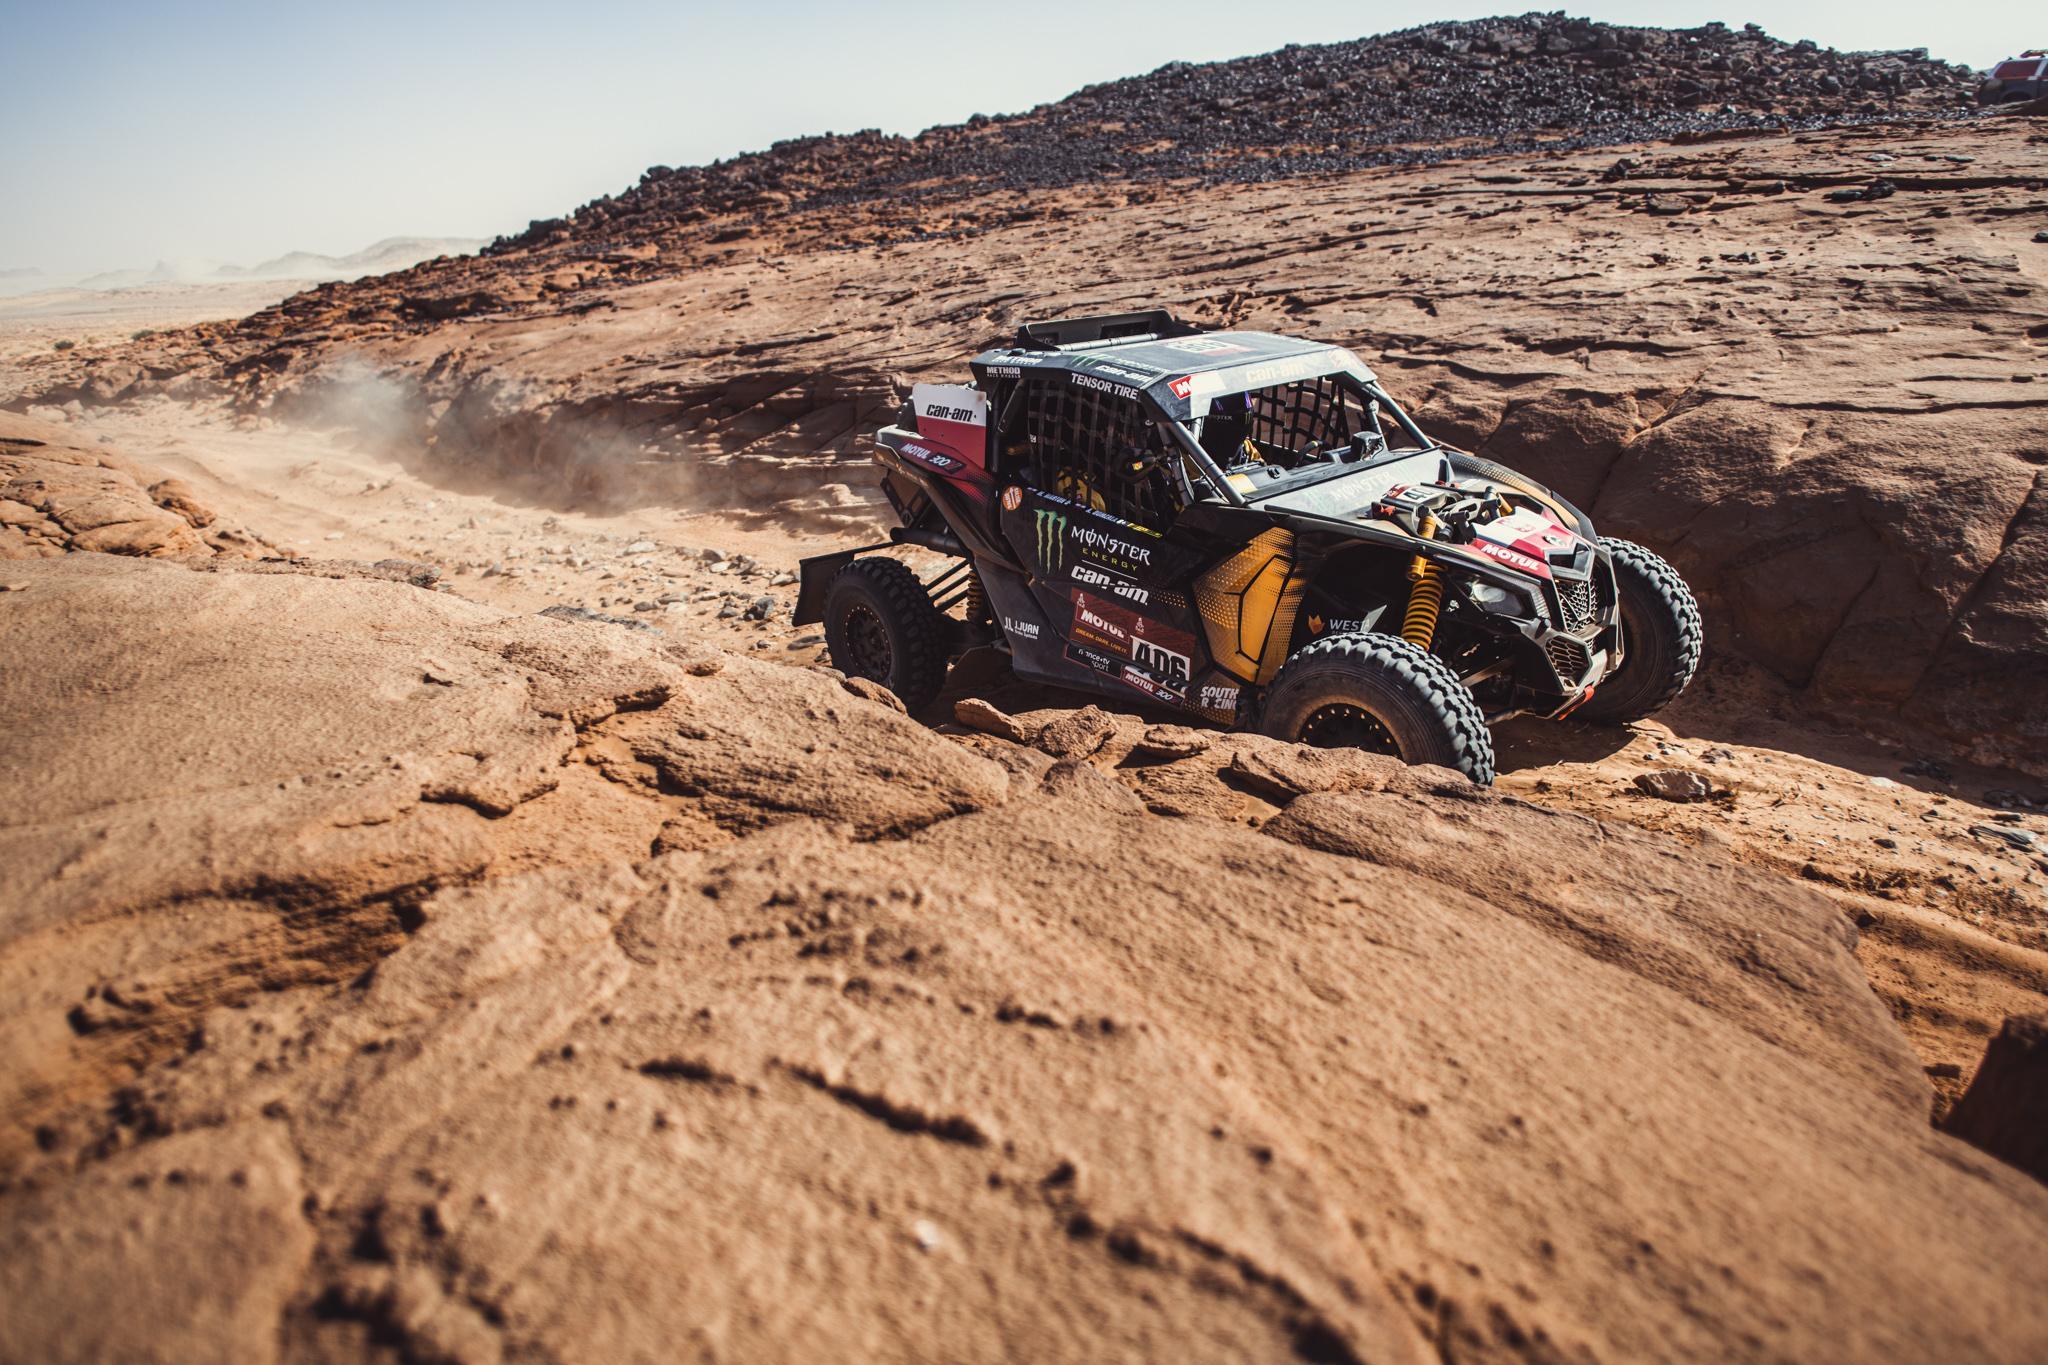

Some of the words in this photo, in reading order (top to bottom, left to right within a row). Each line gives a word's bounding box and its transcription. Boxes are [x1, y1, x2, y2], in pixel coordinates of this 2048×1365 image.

[986, 366, 1021, 375] METHOD
[1071, 372, 1112, 394] TENSOR
[1114, 383, 1139, 400] TIRE
[926, 404, 973, 422] can-am
[900, 443, 931, 460] MOTUL
[1071, 525, 1151, 566] MONSTER
[1481, 543, 1540, 571] MOTUL
[1082, 547, 1138, 572] ENERGY
[1071, 565, 1149, 606] can-am
[1080, 609, 1124, 639] MOTUL
[1125, 672, 1154, 693] MOTUL
[1200, 686, 1240, 700] SOUTH
[1201, 697, 1236, 710] RCIN
